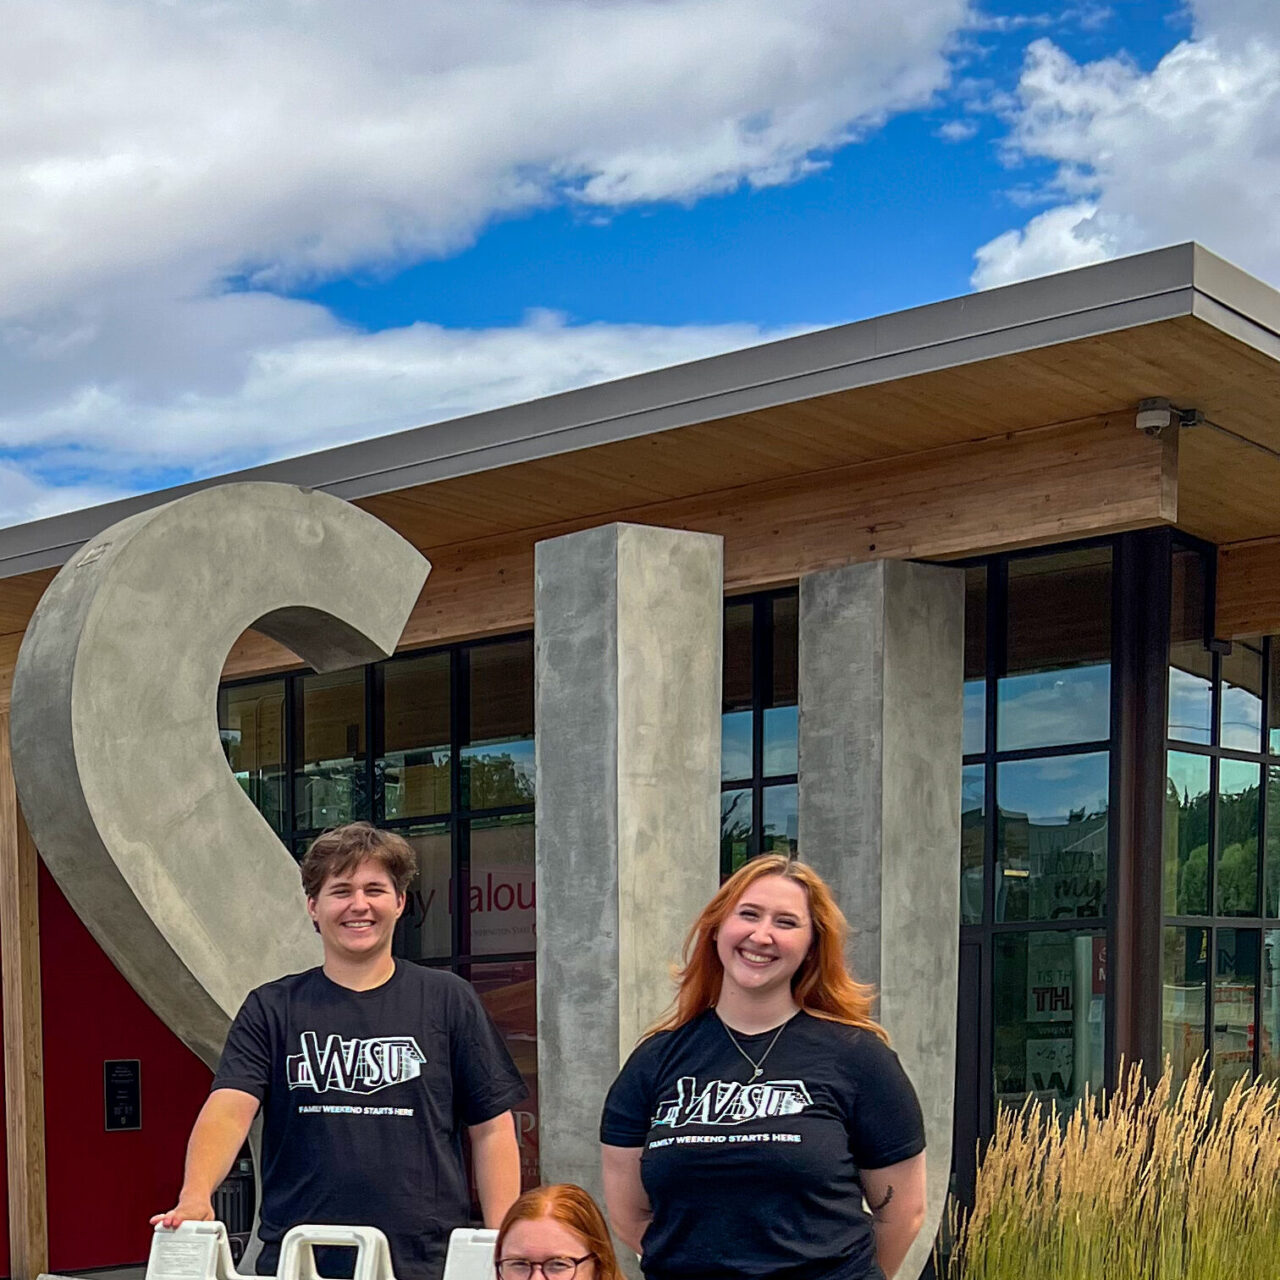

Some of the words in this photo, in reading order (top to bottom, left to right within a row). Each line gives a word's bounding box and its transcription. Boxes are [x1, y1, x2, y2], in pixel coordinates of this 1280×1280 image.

[322, 1105, 362, 1114] WEEKEND
[363, 1107, 394, 1116] STARTS
[394, 1108, 414, 1117] HERE
[676, 1135, 727, 1144] WEEKEND
[728, 1133, 770, 1143] STARTS
[772, 1133, 802, 1143] HERE
